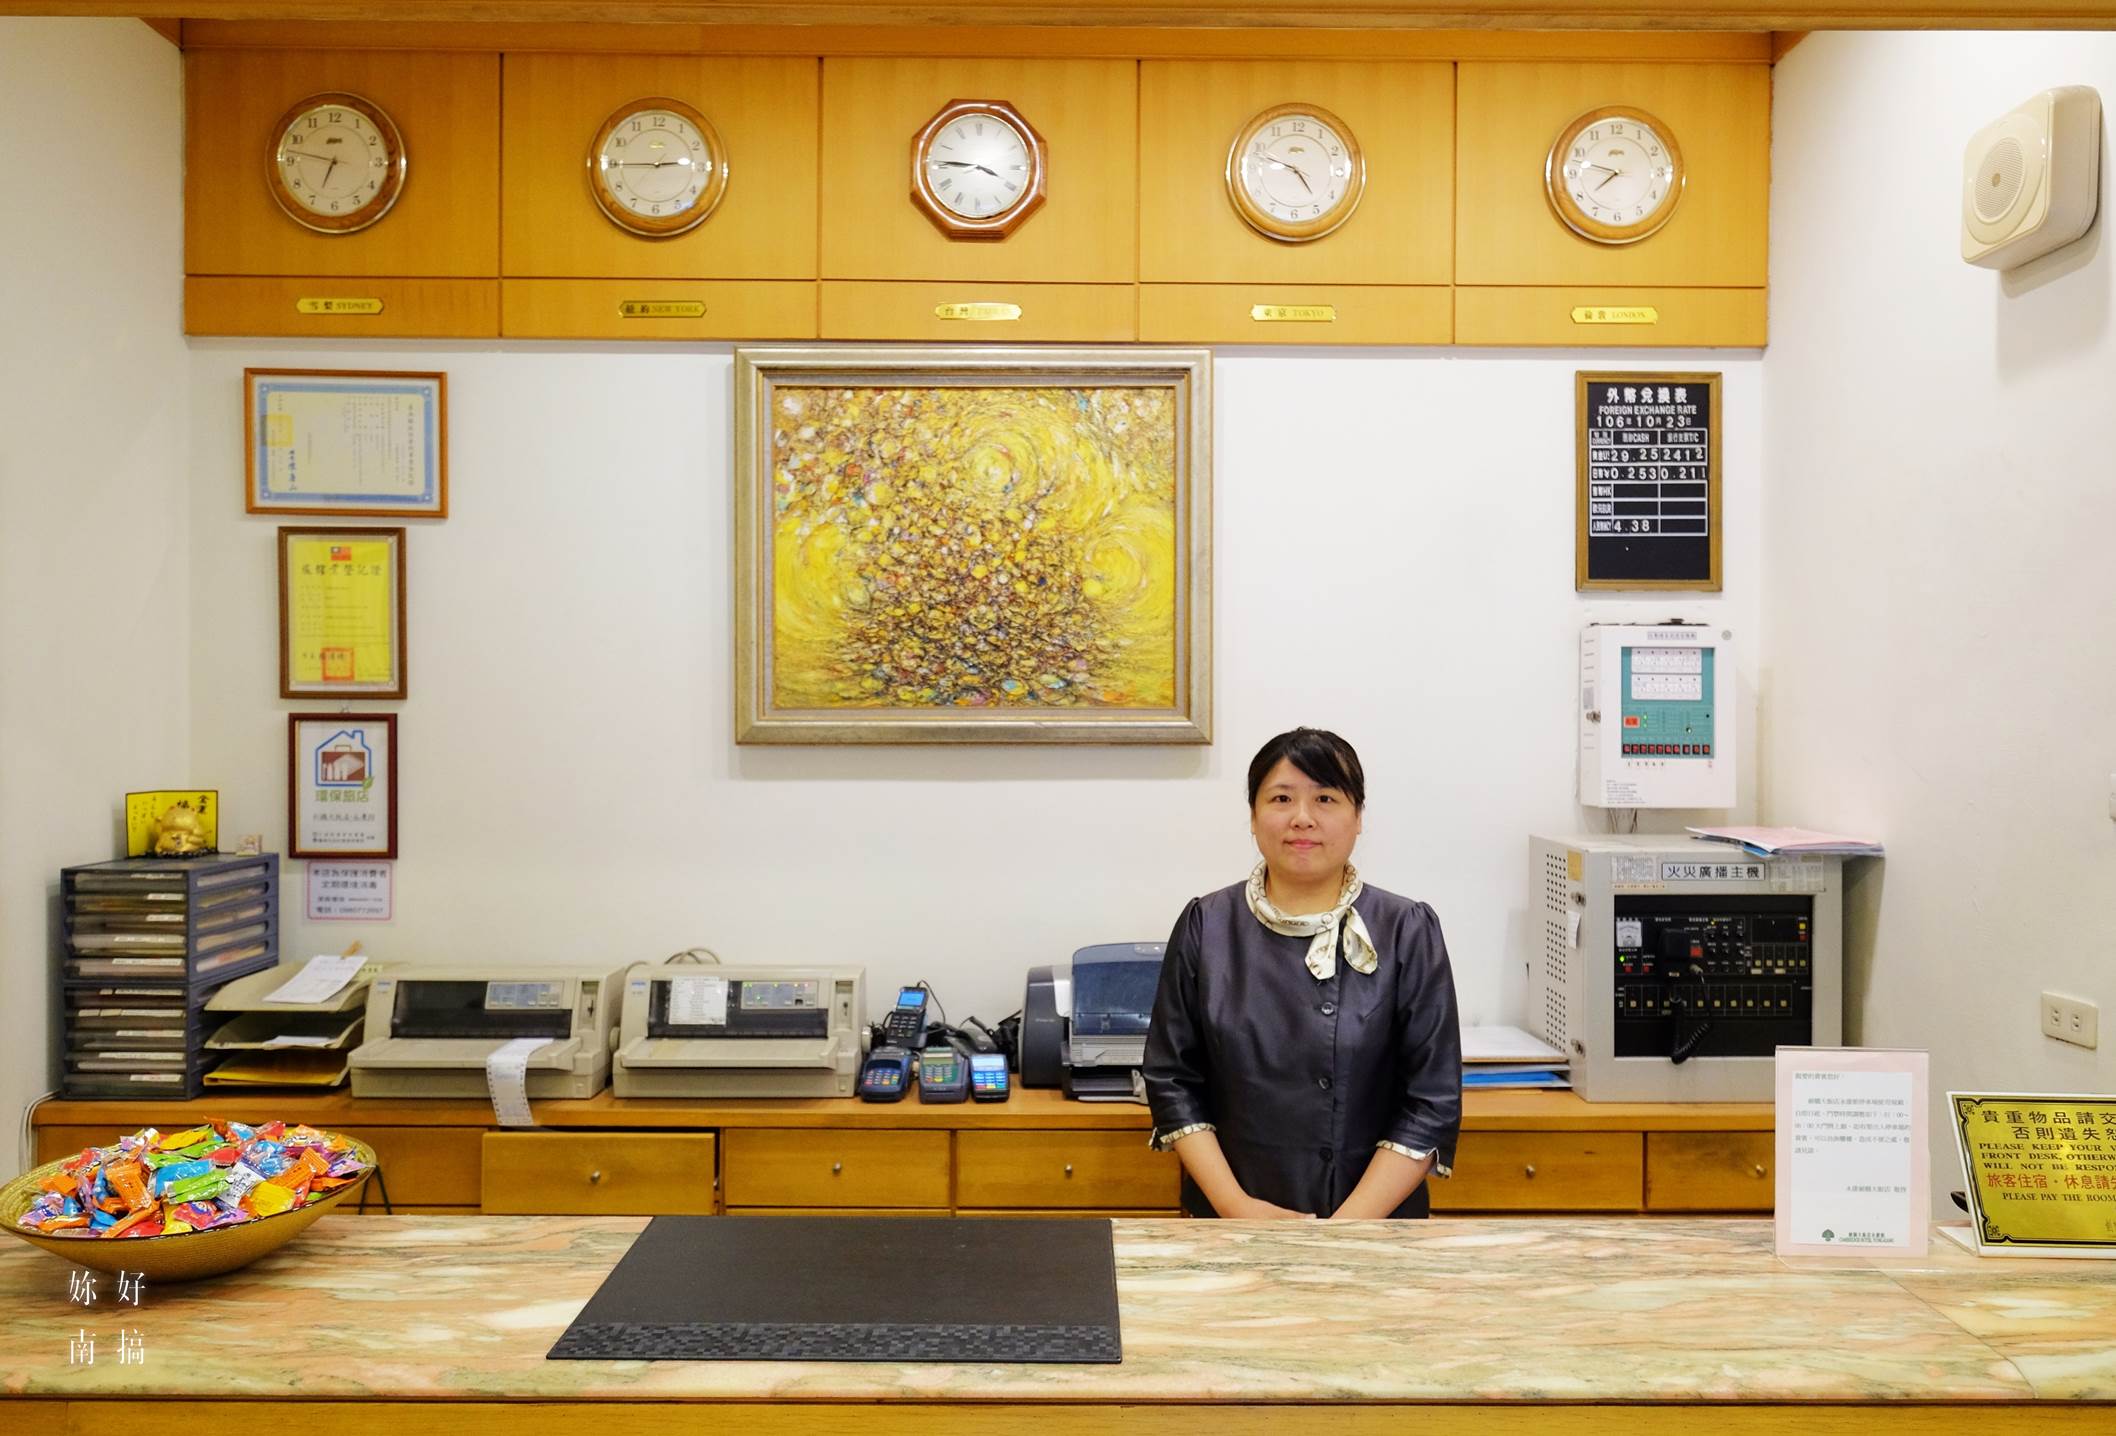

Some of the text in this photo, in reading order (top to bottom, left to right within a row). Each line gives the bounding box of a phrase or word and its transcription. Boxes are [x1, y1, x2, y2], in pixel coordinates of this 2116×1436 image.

[328, 112, 341, 123] 12
[653, 117, 665, 127] 12
[308, 118, 317, 128] 11
[355, 119, 360, 128] 1
[631, 121, 641, 131] 11
[1292, 122, 1305, 132] 12
[679, 124, 684, 133] 1
[1271, 126, 1281, 136] 11
[1611, 124, 1623, 135] 12
[1318, 129, 1323, 139] 1
[1590, 130, 1599, 140] 11
[1637, 130, 1641, 140] 1
[292, 135, 303, 144] 10
[369, 136, 377, 146] 2
[615, 138, 627, 147] 10
[692, 141, 700, 151] 2
[1254, 142, 1266, 152] 10
[1331, 146, 1339, 156] 2
[1574, 148, 1585, 157] 10
[1650, 146, 1658, 157] 2
[286, 157, 295, 166] 9
[374, 157, 383, 167] 3
[1569, 169, 1577, 179] 9
[1657, 167, 1665, 177] 3
[294, 179, 301, 189] 8
[368, 180, 375, 189] 4
[689, 185, 696, 195] 4
[1650, 190, 1656, 200] 4
[309, 195, 316, 205] 7
[352, 195, 361, 205] 5
[1576, 192, 1584, 201] 8
[330, 201, 338, 211] 6
[630, 198, 637, 208] 7
[674, 199, 681, 210] 5
[651, 204, 660, 214] 6
[1290, 209, 1298, 219] 6
[1312, 204, 1320, 214] 5
[1592, 207, 1599, 217] 7
[1636, 206, 1643, 216] 5
[1613, 212, 1621, 222] 6
[336, 302, 373, 310] SYDNEY
[652, 305, 672, 313] NEW
[675, 305, 699, 313] YORK
[1292, 309, 1324, 318] TOKYO
[1612, 311, 1647, 319] LONDON
[1599, 405, 1698, 415] FOREIGN EXCHANGE RATE
[1613, 519, 1650, 533] 4.38
[1667, 865, 1760, 879] 火災廣播主機
[1981, 1110, 2116, 1126] 貴重物品請交
[1979, 1142, 2025, 1151] PLEASE
[2032, 1143, 2064, 1151] KEEP
[2069, 1144, 2102, 1152] YOUR
[1981, 1152, 2022, 1160] FRONT
[2029, 1153, 2063, 1161] DESK,
[1983, 1162, 2013, 1170] WILL
[2020, 1163, 2044, 1171] NOT
[2002, 1192, 2038, 1201] PLEASE
[2040, 1193, 2058, 1201] PAY
[2061, 1193, 2082, 1202] THE
